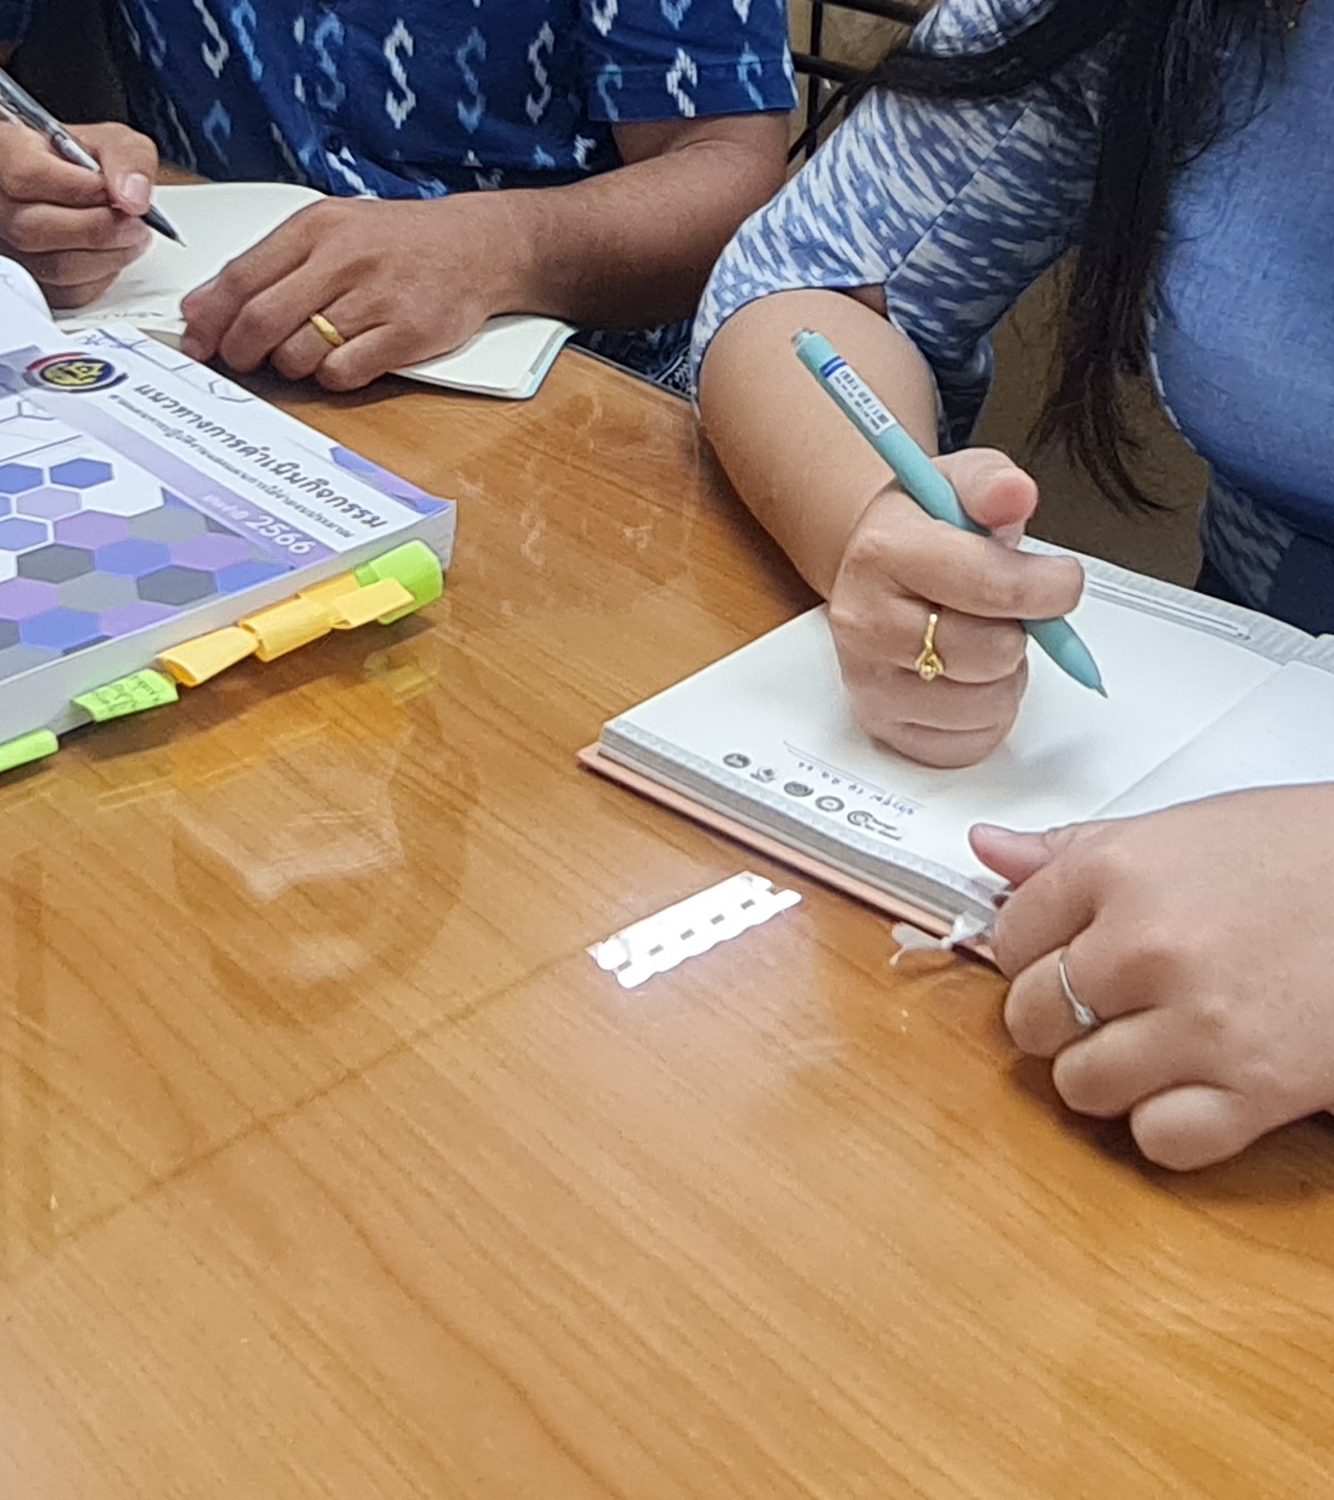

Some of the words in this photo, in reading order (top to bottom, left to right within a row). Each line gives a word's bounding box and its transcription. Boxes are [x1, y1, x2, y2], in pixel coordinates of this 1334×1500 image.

[133, 383, 389, 529] แนวทางการดำเนินกิจกรรม
[243, 515, 317, 555] 2566
